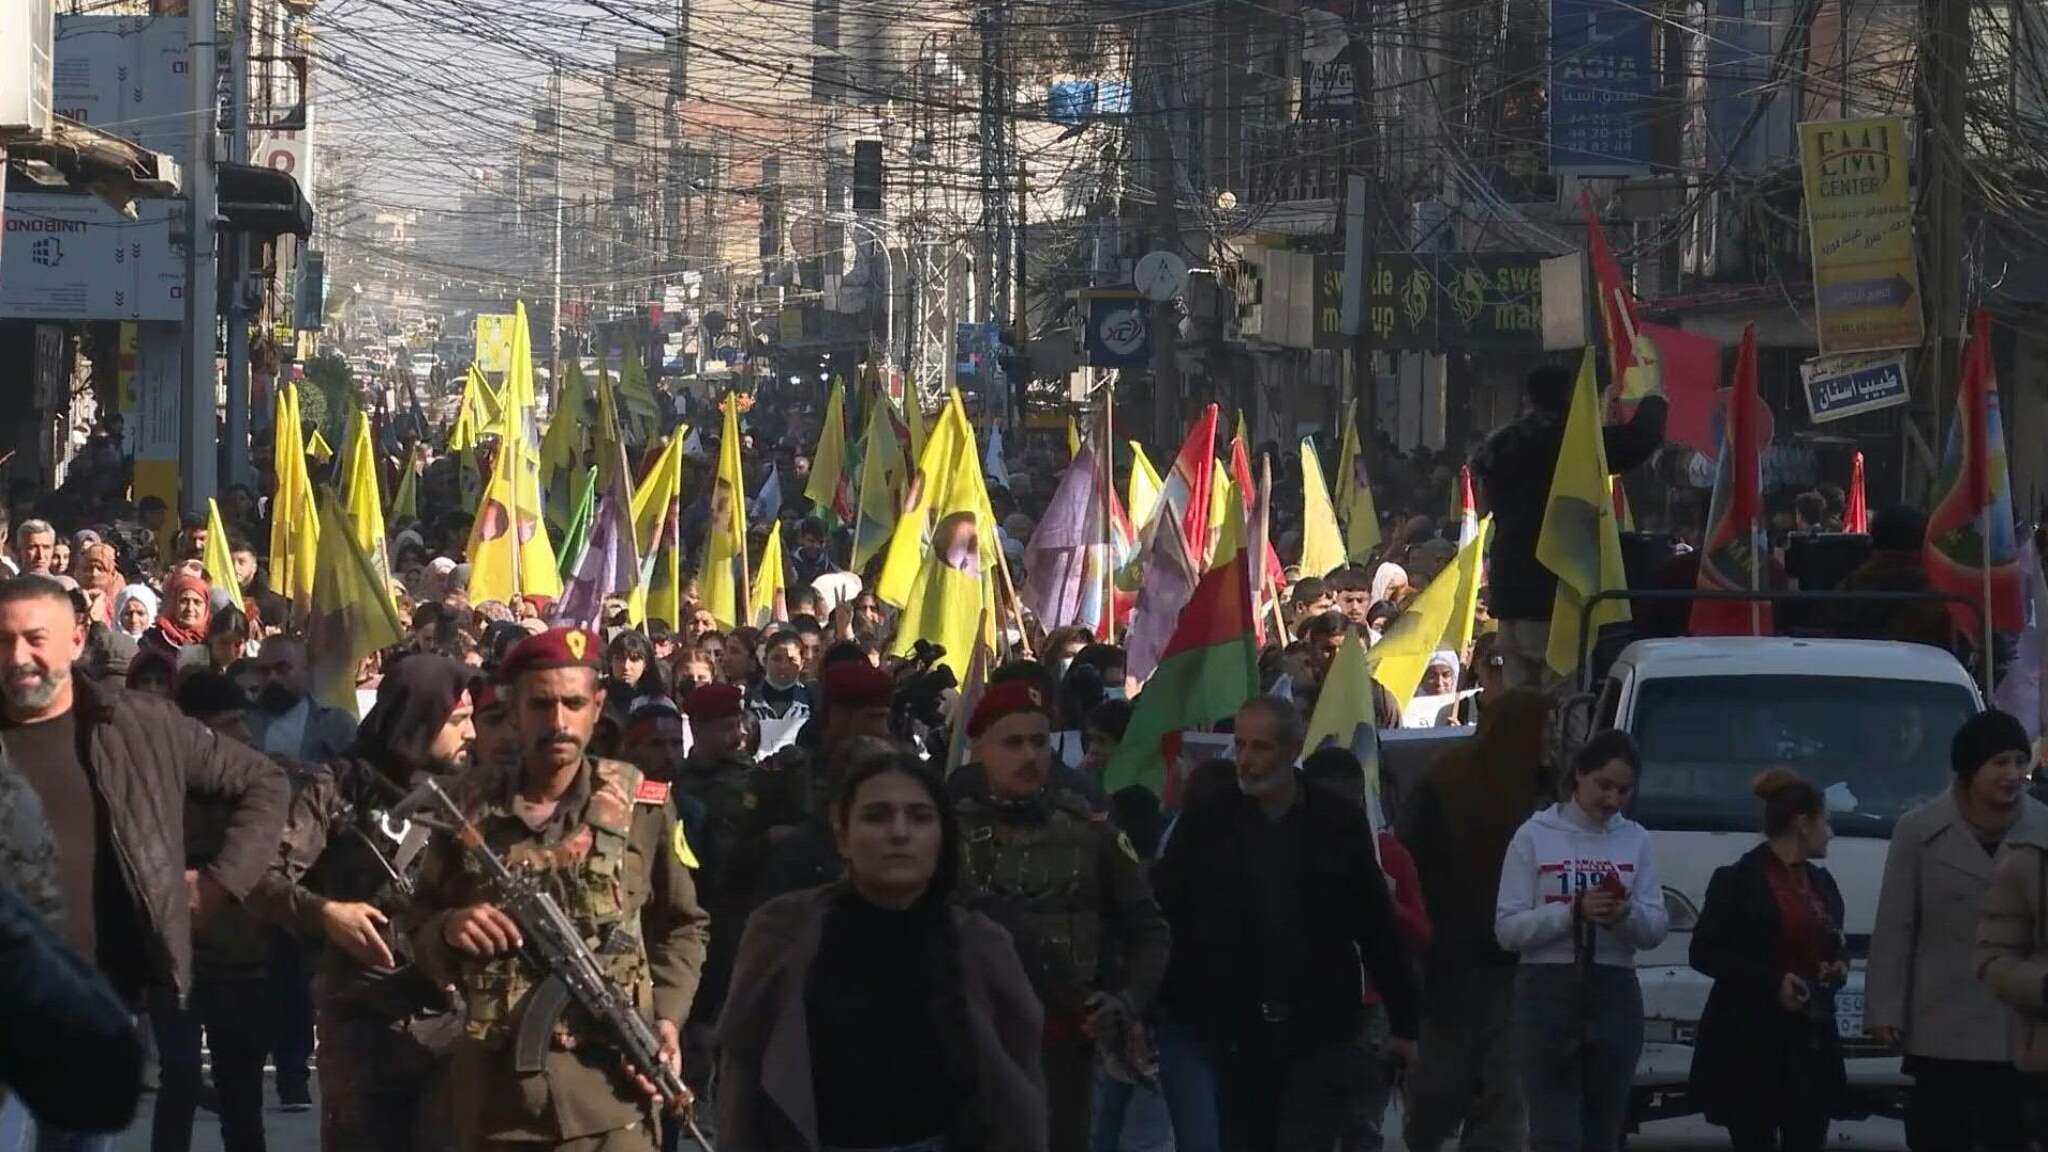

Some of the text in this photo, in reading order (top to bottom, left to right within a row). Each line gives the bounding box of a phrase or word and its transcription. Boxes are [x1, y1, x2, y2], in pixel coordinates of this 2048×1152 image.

[1819, 176, 1882, 197] CENTER
[5, 218, 87, 233] UNIBOND
[1858, 369, 1897, 400] طبيب
